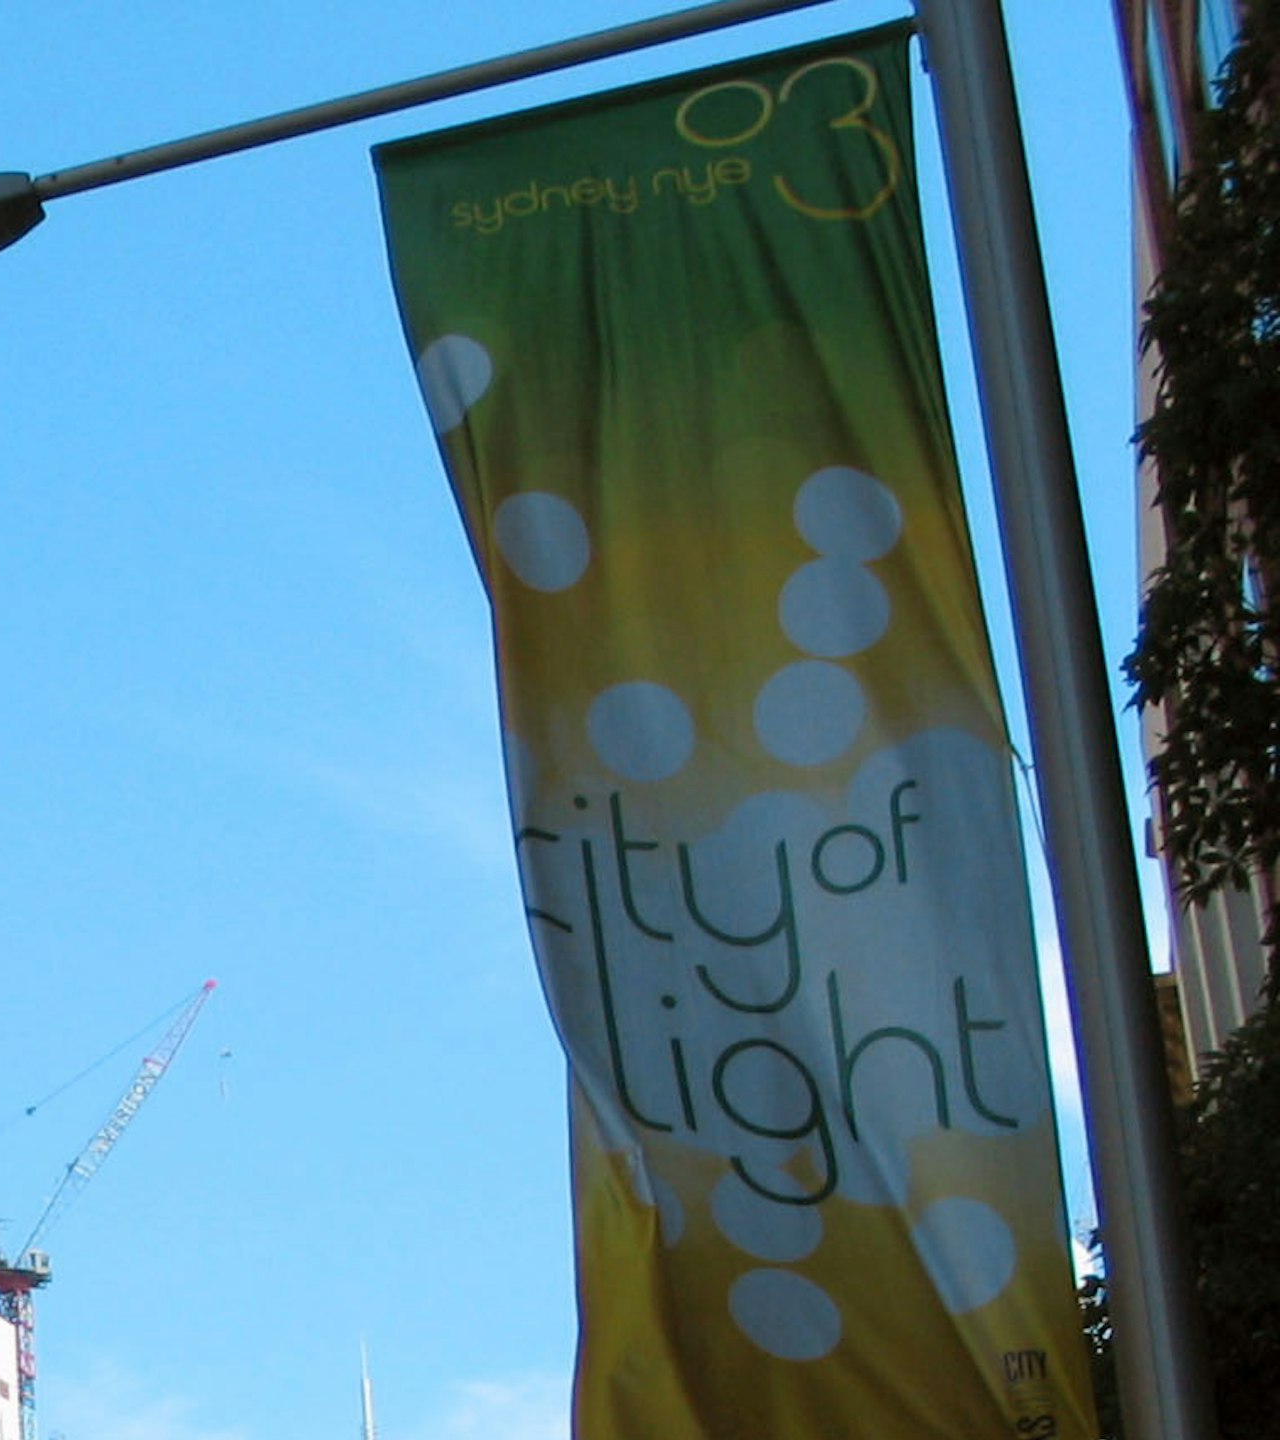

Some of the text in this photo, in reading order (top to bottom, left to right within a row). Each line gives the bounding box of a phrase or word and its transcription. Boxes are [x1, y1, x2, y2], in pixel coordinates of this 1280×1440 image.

[450, 155, 752, 234] sydney nye
[810, 780, 921, 896] of
[586, 968, 1018, 1207] light
[1004, 1350, 1048, 1381] CITY
